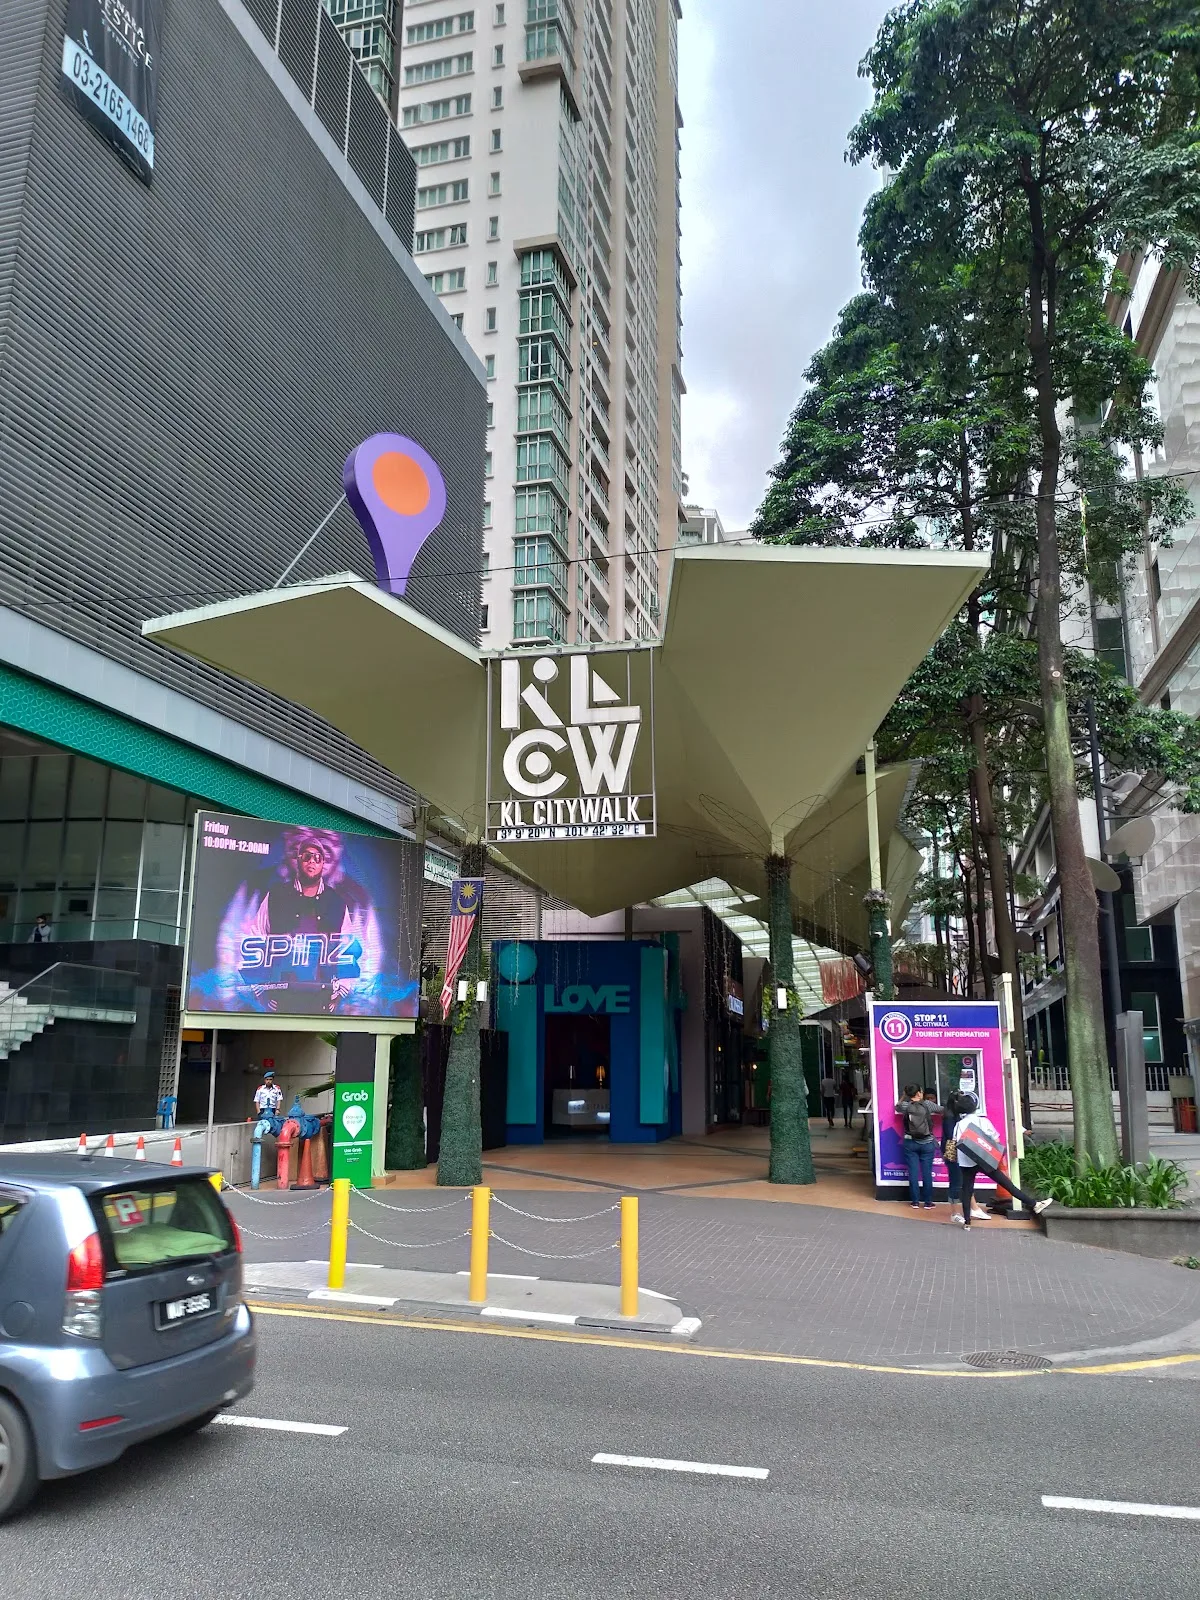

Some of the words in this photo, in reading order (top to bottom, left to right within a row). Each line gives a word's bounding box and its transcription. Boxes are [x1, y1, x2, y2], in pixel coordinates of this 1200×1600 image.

[73, 52, 124, 122] 03-2165
[126, 108, 150, 154] 1468
[500, 802, 527, 827] KL
[533, 796, 641, 826] CITYWALK
[203, 820, 230, 836] Friday
[550, 827, 556, 838] N
[203, 835, 270, 855] 10:00PM-12:00AM
[544, 983, 630, 1013] LOVE
[914, 1014, 936, 1022] STOP
[937, 1014, 947, 1022] 11
[888, 1022, 903, 1034] 11
[915, 1030, 943, 1038] TOURIST
[341, 1090, 369, 1102] Grab
